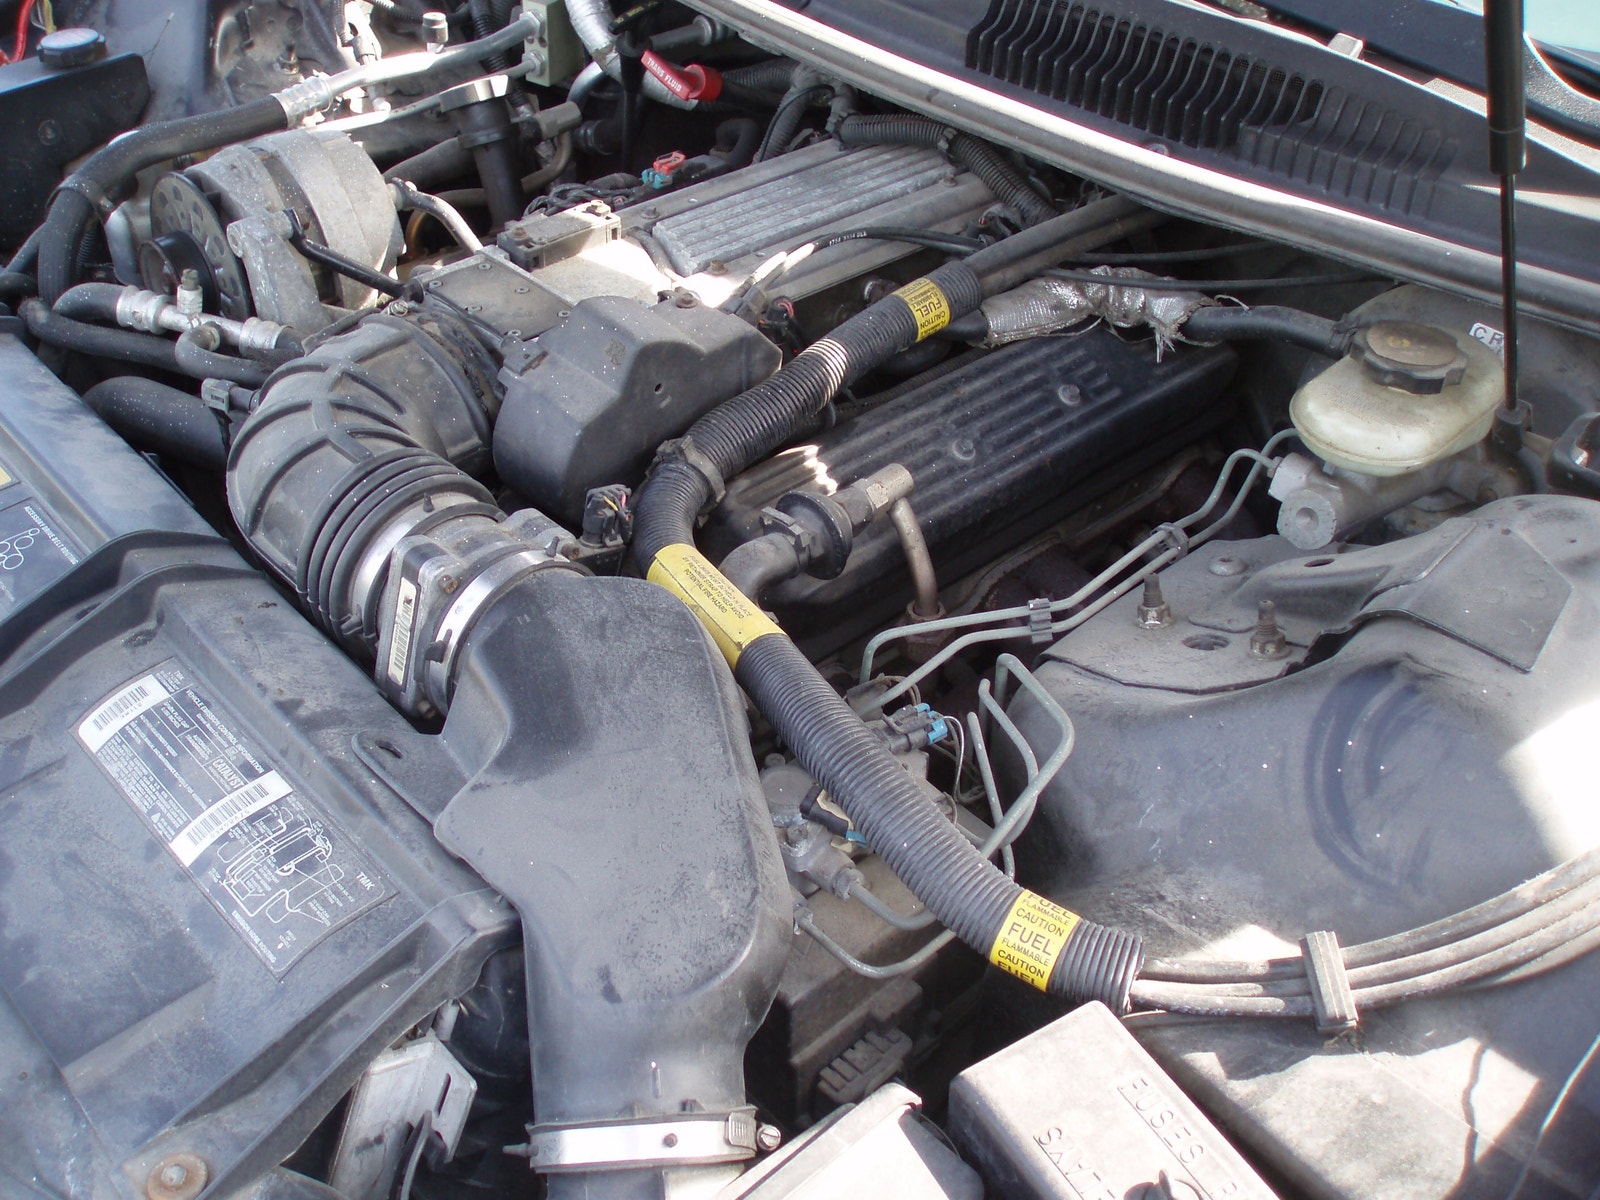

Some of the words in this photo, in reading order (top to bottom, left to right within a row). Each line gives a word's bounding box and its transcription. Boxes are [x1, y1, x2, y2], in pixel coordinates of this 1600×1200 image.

[648, 57, 665, 77] TRANS
[664, 74, 682, 92] FLUID
[915, 298, 943, 318] FUEL
[920, 310, 946, 330] CAUTION
[41, 525, 55, 537] DRIVE
[51, 537, 64, 547] BELT
[682, 568, 705, 590] POTENTIAL
[701, 587, 713, 598] FIRE
[710, 596, 728, 613] HAZARD
[703, 578, 718, 592] STRAP
[720, 595, 733, 607] HELP
[730, 606, 744, 619] AVOID
[185, 689, 204, 707] VEHICLE
[200, 705, 220, 725] EMISSION
[217, 724, 237, 745] CONTROL
[234, 743, 265, 774] INFORMATION
[211, 757, 244, 790] CATALYST
[355, 871, 375, 890] TMK
[1016, 907, 1065, 938] CAUTION
[1022, 898, 1069, 927] FLAMMABLE
[230, 909, 251, 932] EMISSION
[257, 941, 277, 963] ROUTING
[1001, 937, 1050, 967] FLAMMABLE
[1007, 921, 1052, 957] FUEL
[997, 949, 1046, 980] CAUTION
[1121, 1078, 1204, 1164] FUSES
